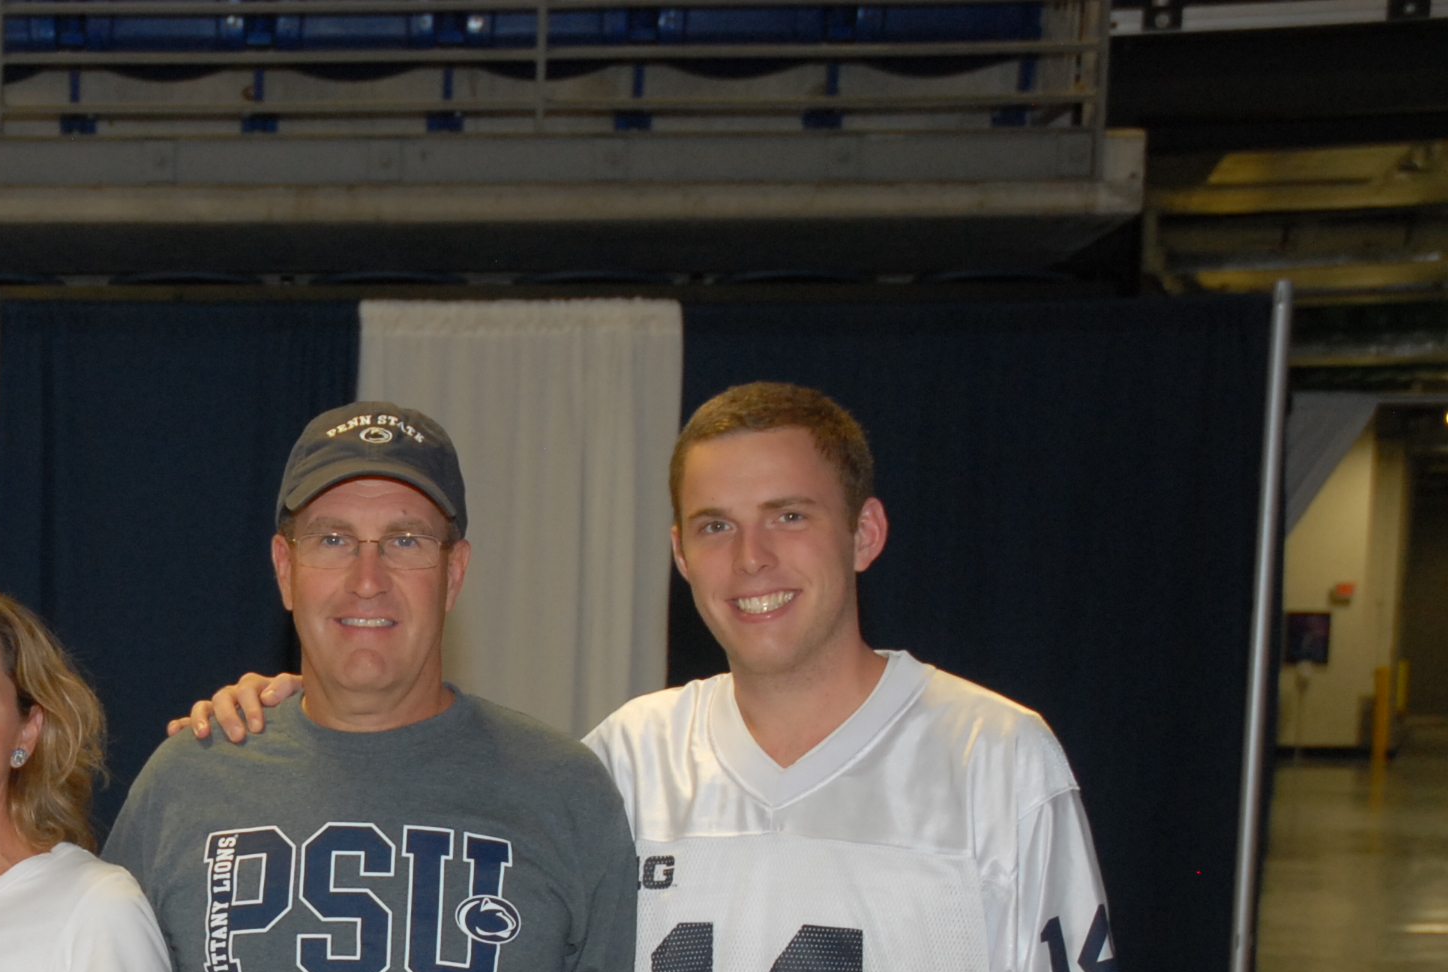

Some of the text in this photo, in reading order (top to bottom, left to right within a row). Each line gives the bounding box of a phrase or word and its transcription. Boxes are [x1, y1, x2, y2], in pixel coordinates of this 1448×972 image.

[326, 414, 425, 443] PENN STATE
[213, 836, 237, 893] LIONS
